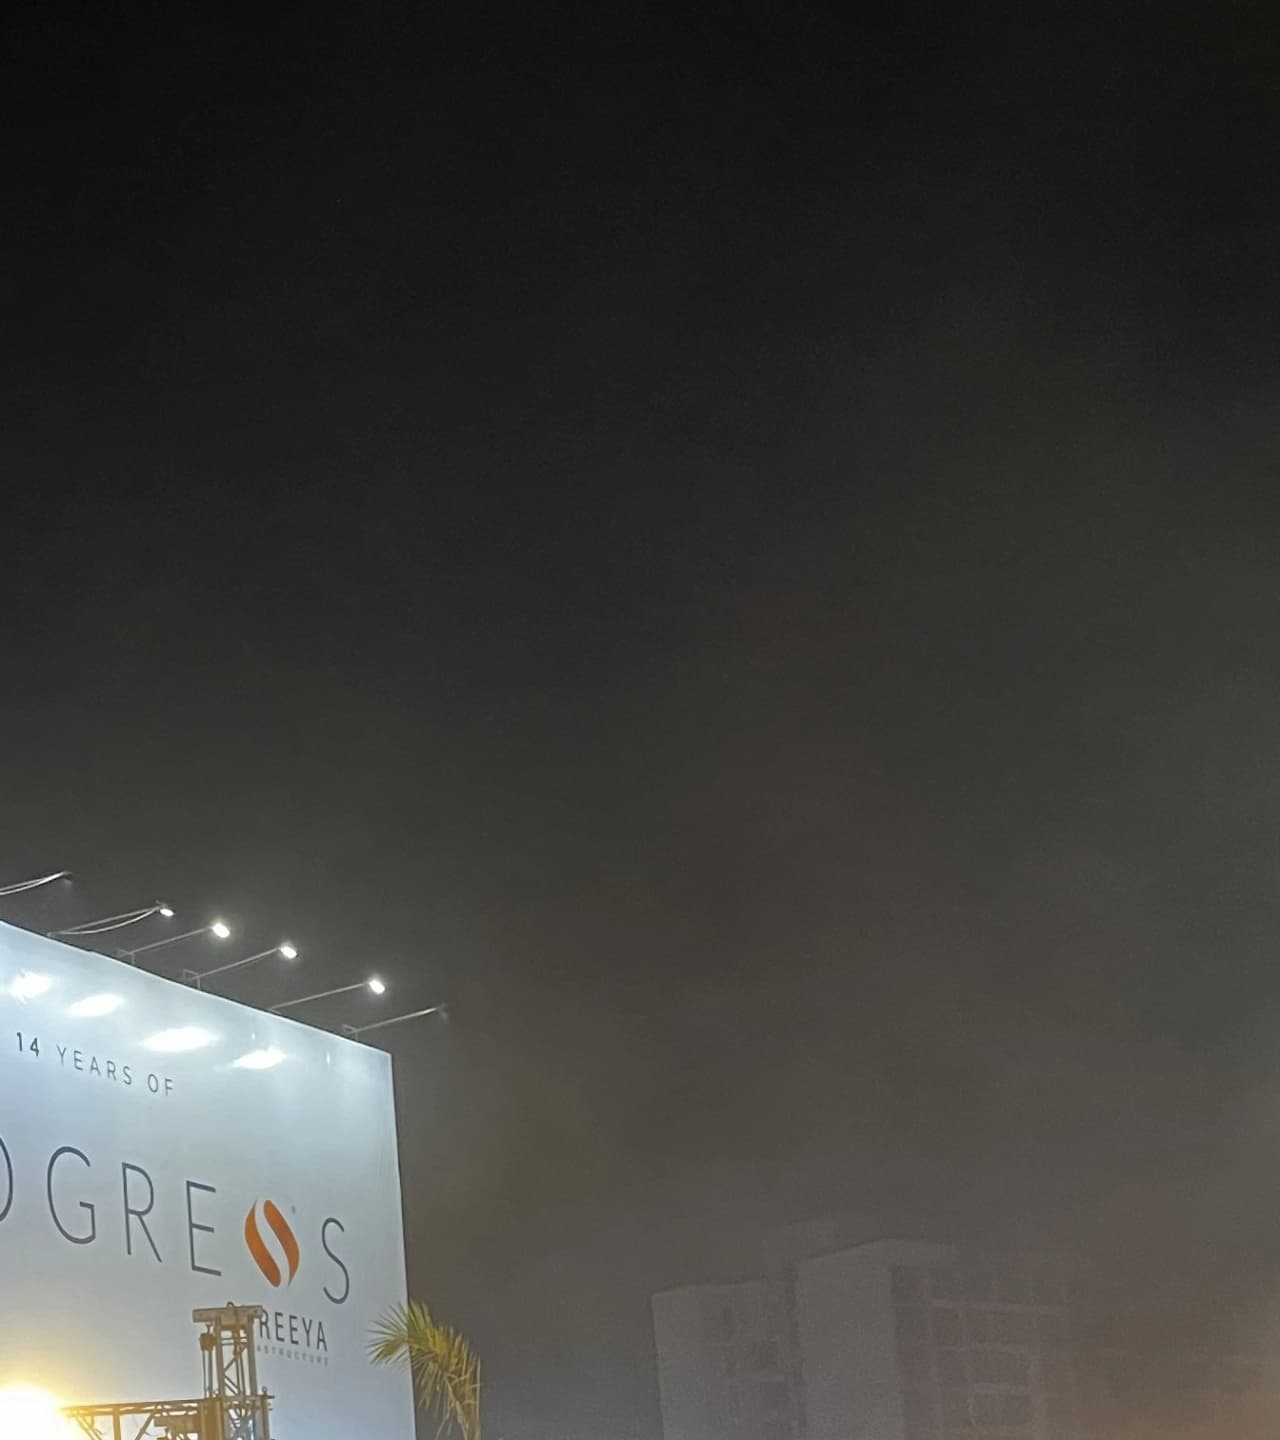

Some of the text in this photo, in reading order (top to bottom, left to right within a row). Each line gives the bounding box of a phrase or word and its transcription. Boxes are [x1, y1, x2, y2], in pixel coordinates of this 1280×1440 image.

[16, 1031, 173, 1097] 14 YEARS OF
[259, 1308, 328, 1352] REEYA
